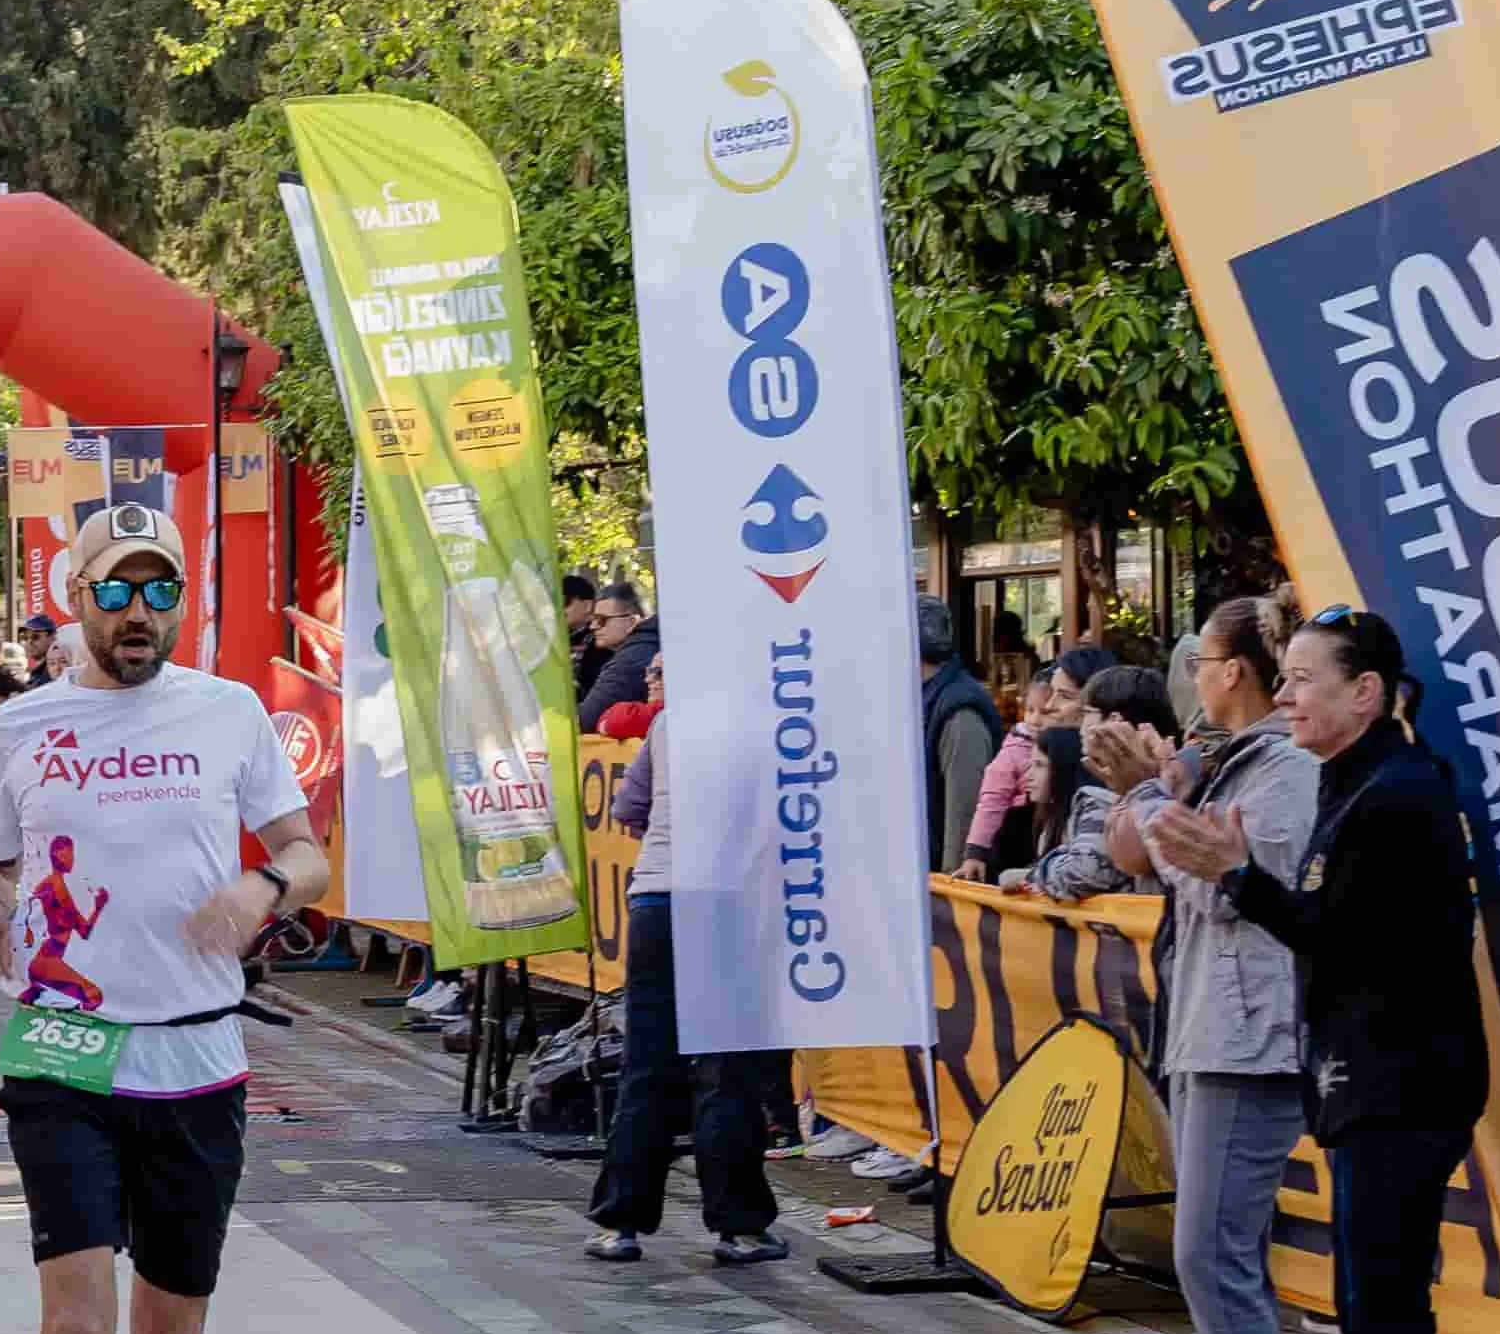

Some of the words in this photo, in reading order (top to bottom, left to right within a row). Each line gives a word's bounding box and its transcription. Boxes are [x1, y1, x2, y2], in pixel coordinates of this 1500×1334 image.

[13, 459, 63, 483] EUM
[114, 457, 163, 483] EUM
[40, 746, 200, 790] Aydem
[96, 783, 201, 806] perakende
[21, 1017, 107, 1055] 2639
[1034, 1081, 1098, 1156] Limit
[976, 1137, 1091, 1216] Sensin!
